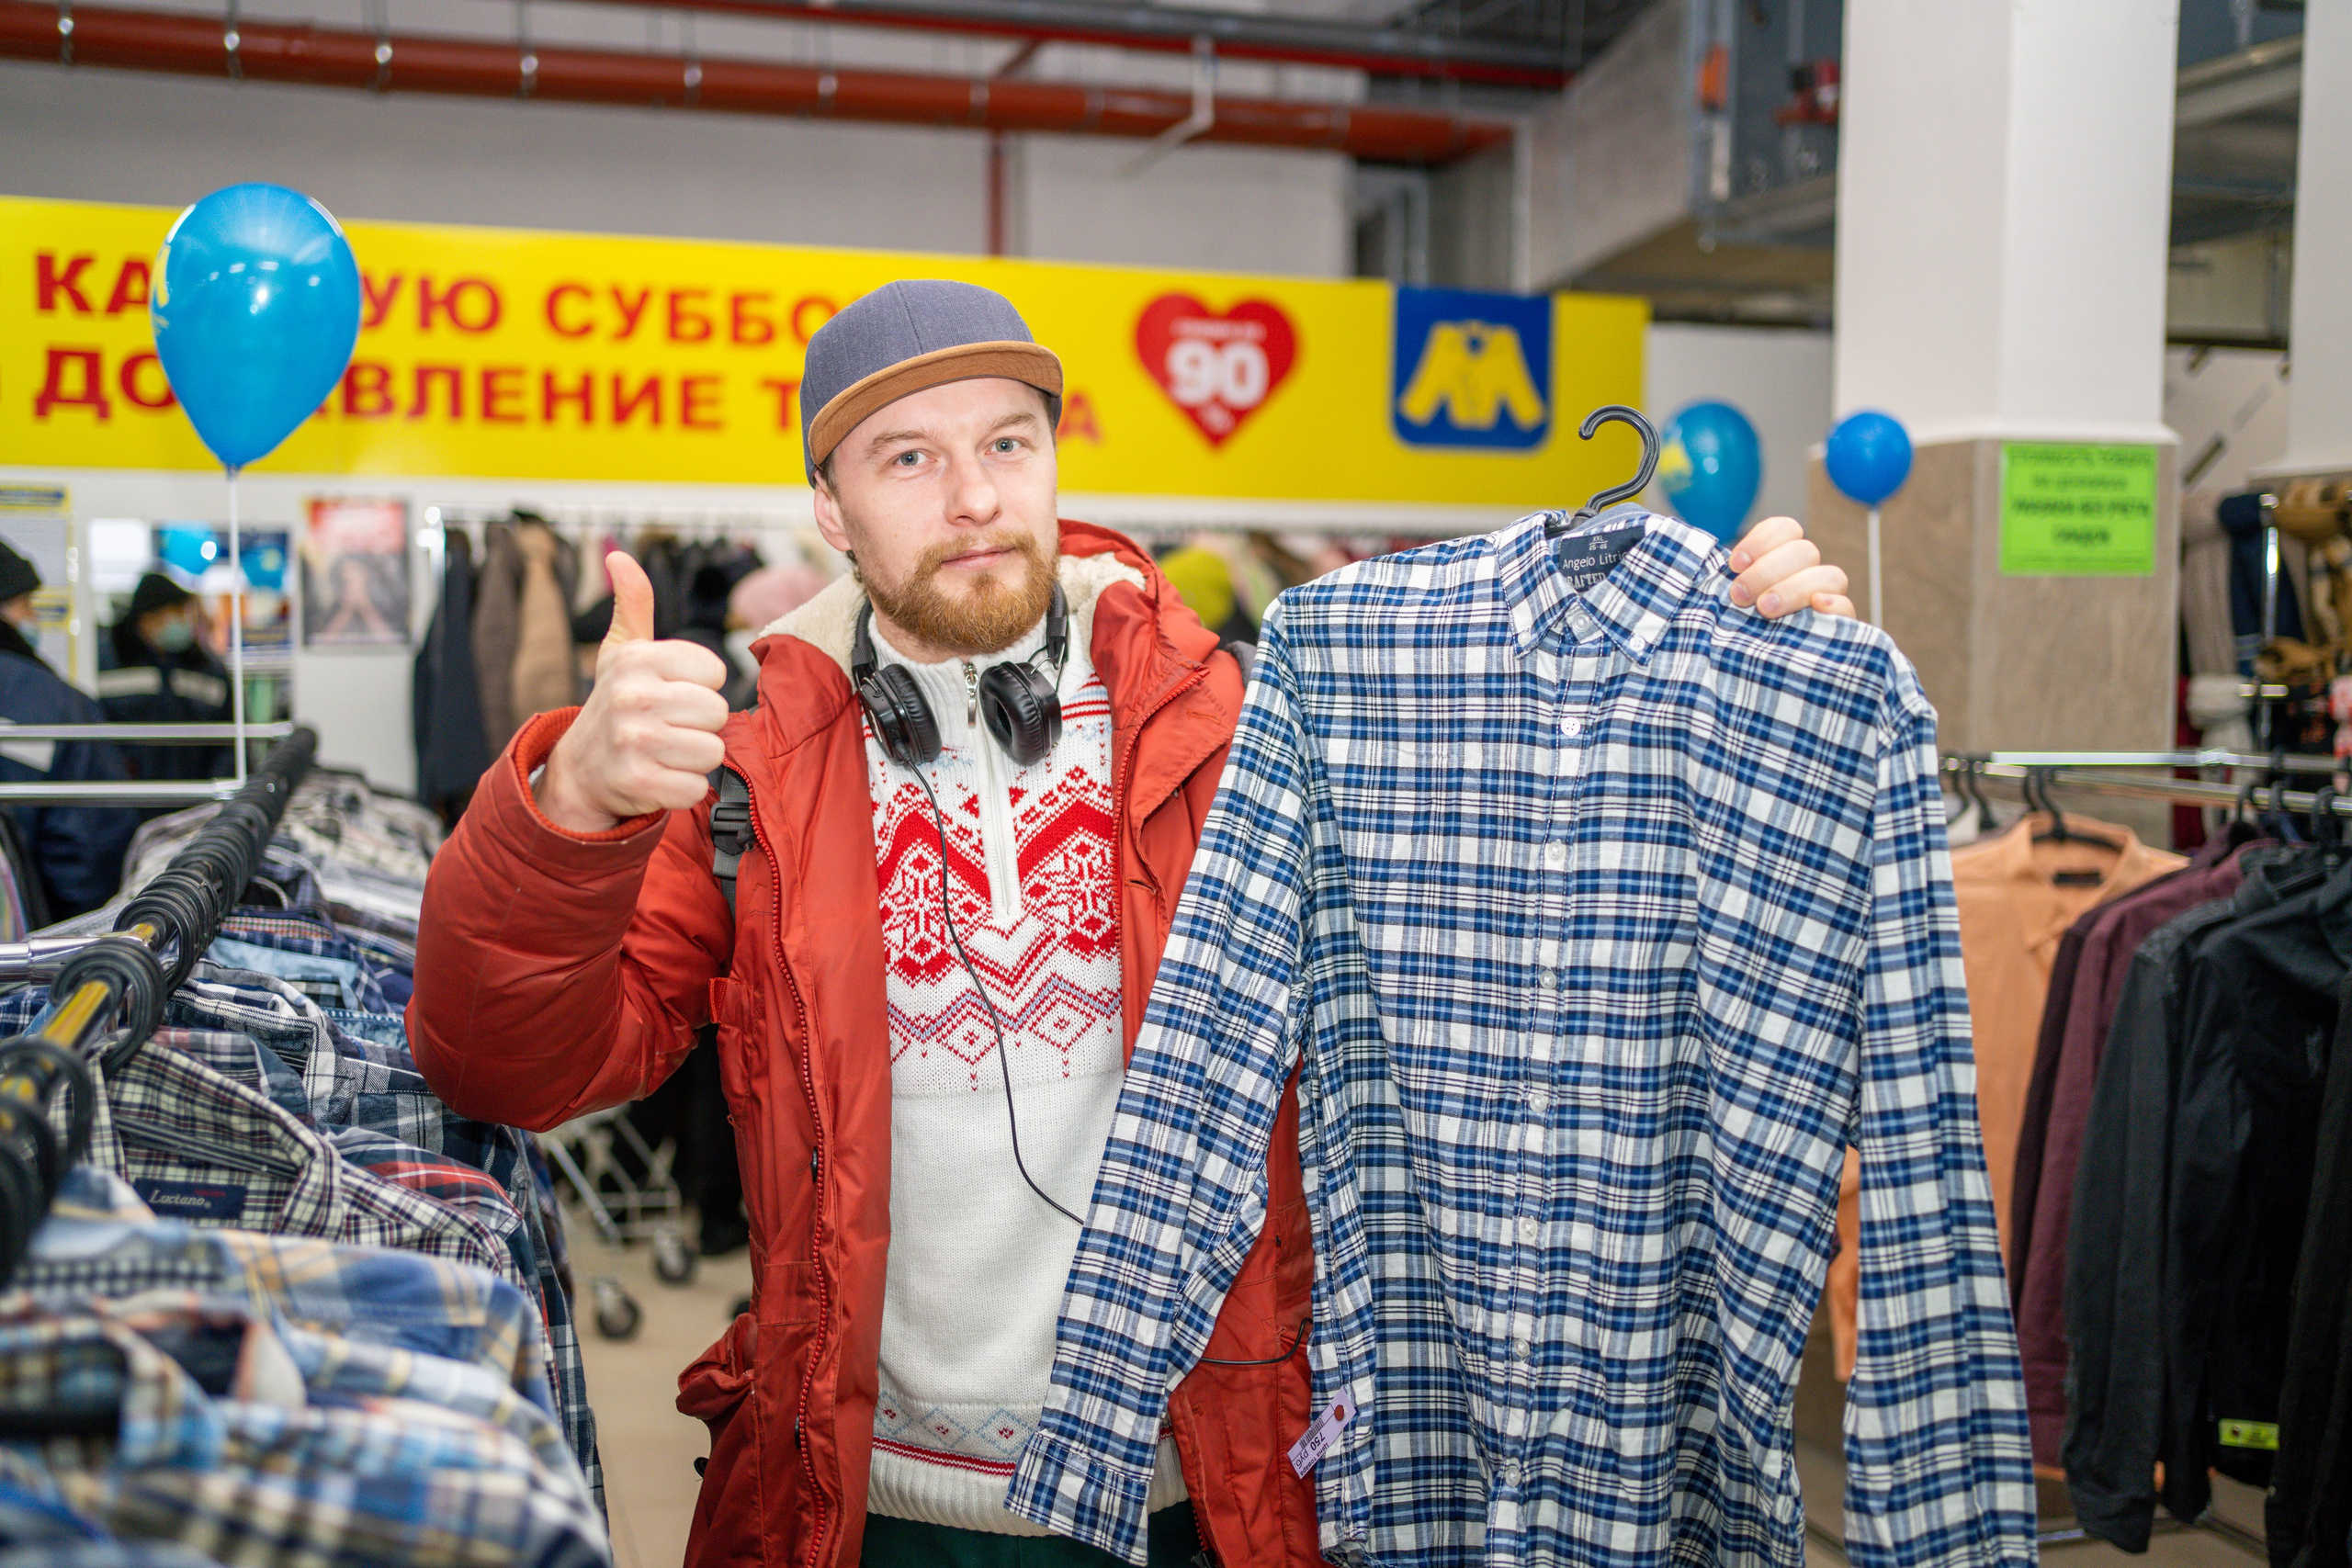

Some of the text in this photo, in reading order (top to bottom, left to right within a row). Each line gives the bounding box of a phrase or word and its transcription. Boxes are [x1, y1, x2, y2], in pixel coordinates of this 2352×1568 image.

[34, 251, 842, 347] КАУЮ СУББО
[34, 346, 723, 433] ДОВЛЕНИЕ
[1165, 339, 1270, 410] 90
[1563, 551, 1628, 571] Angelo Litric
[1566, 572, 1607, 590] RAFTED
[1310, 1431, 1326, 1451] 750
[1299, 1442, 1329, 1476] Цена товара
